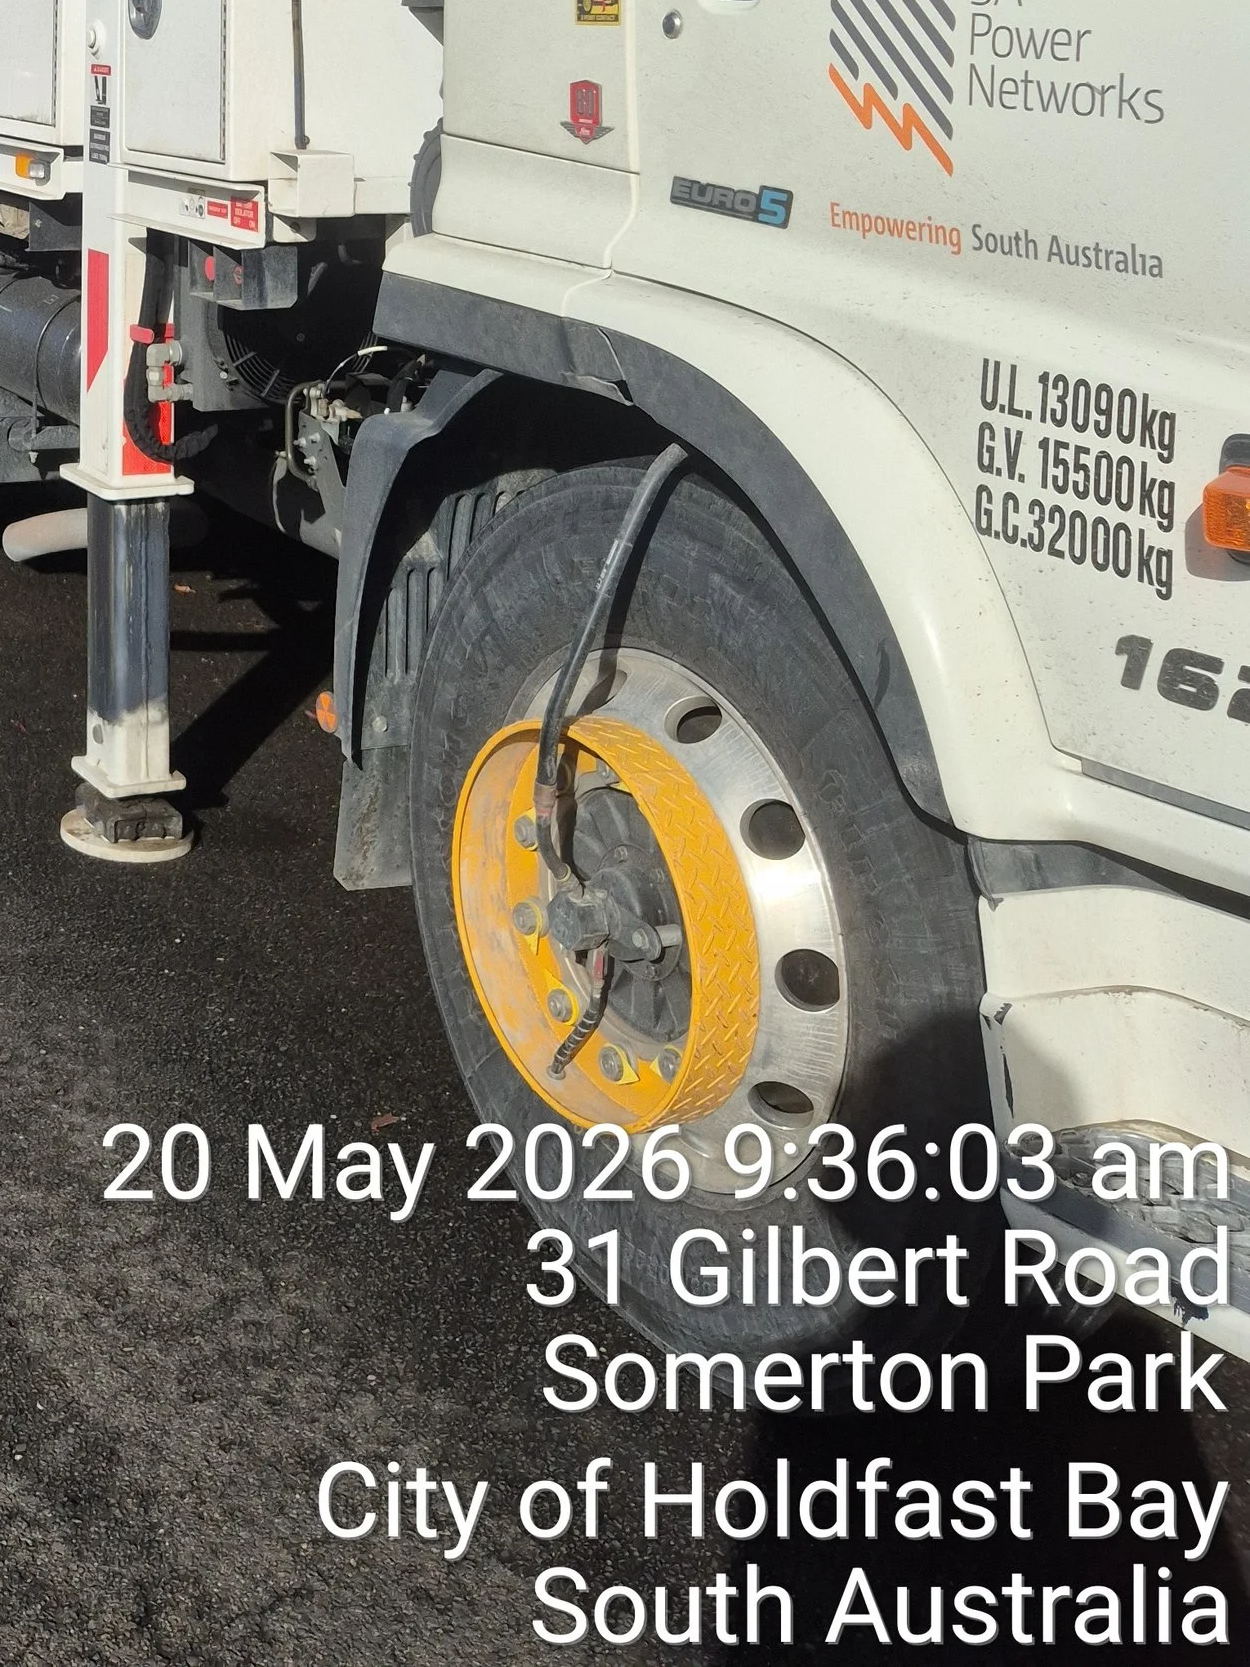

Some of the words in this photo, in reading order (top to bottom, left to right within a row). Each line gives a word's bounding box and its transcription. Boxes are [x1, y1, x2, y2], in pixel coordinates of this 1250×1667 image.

[970, 12, 1092, 63] Power
[968, 62, 1165, 125] Networks
[829, 202, 962, 256] Empowering
[971, 224, 1039, 261] South
[1047, 235, 1164, 279] Australia
